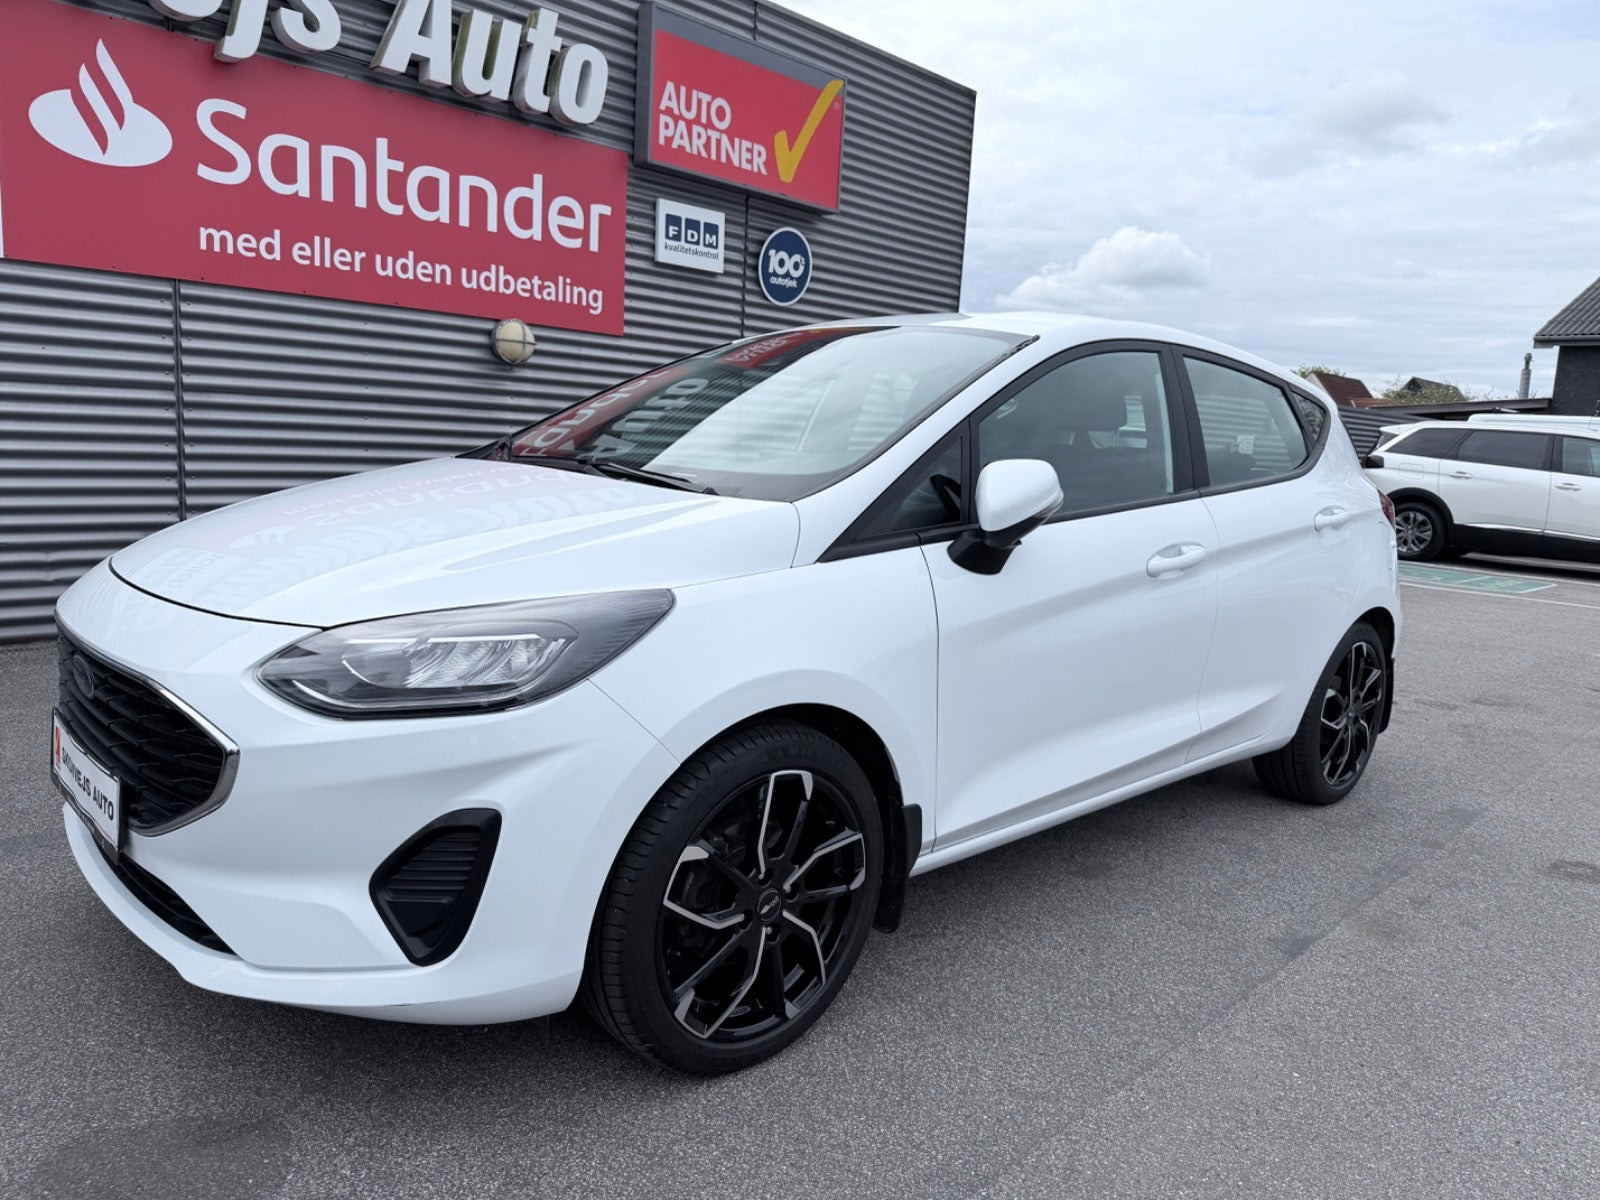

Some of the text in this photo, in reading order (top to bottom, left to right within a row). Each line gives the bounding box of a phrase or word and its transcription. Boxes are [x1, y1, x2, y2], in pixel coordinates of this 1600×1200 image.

[372, 0, 609, 125] Auto
[659, 80, 732, 130] AUTO
[658, 113, 768, 176] PARTNER
[196, 97, 612, 253] Santander
[664, 241, 719, 260] kvalitetskontrol
[668, 224, 718, 248] FDM
[199, 225, 604, 316] med eller uden udbetaling
[93, 785, 114, 821] AUTO
